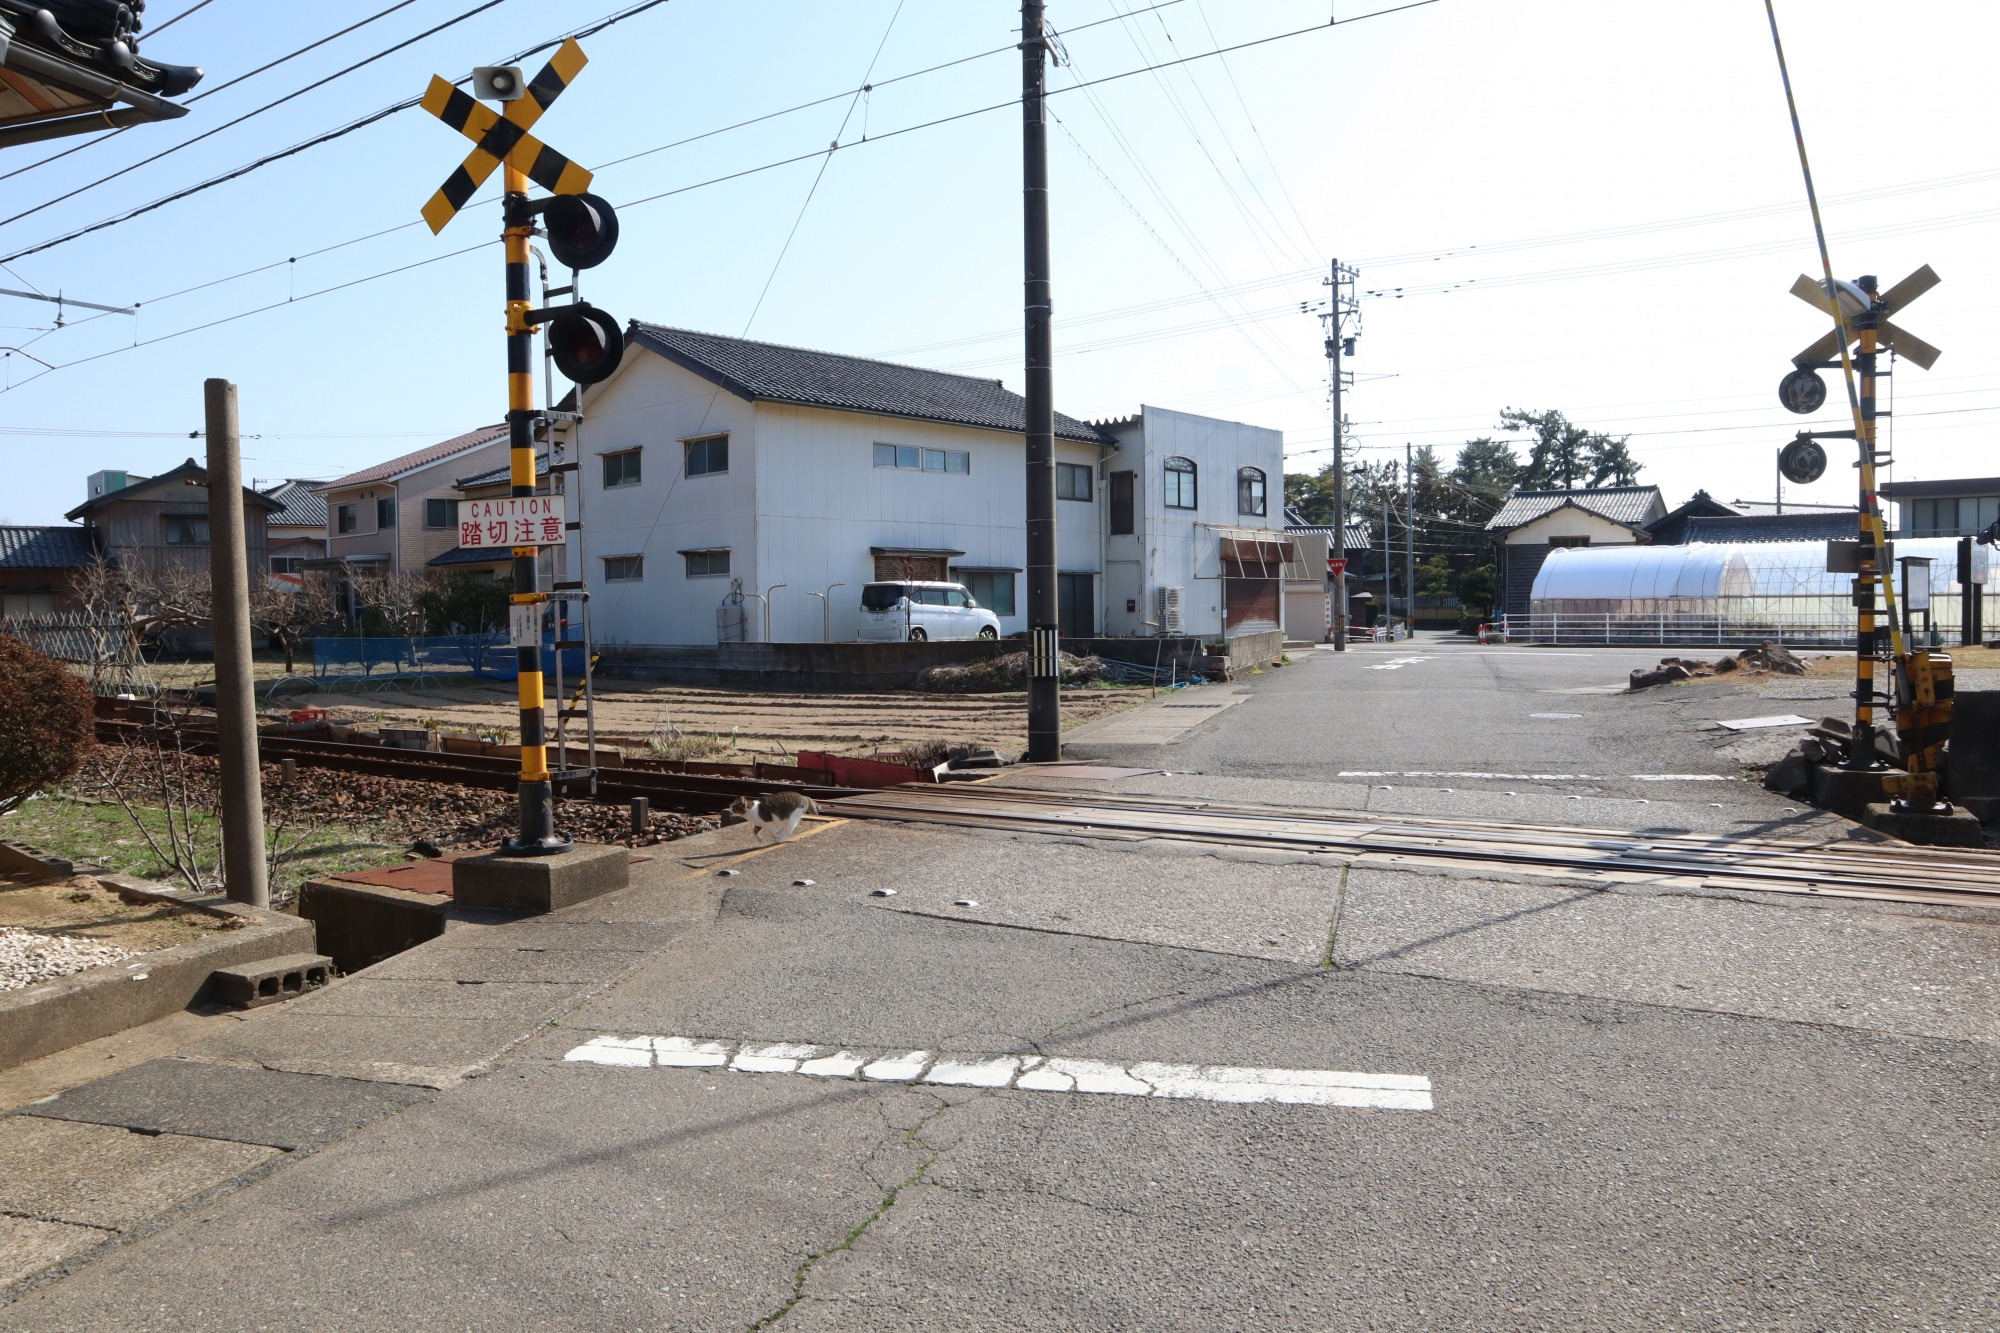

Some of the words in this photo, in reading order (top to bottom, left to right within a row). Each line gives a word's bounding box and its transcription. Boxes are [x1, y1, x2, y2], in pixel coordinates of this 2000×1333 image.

[471, 499, 551, 518] CAUTION
[461, 516, 563, 546] 踏切注意
